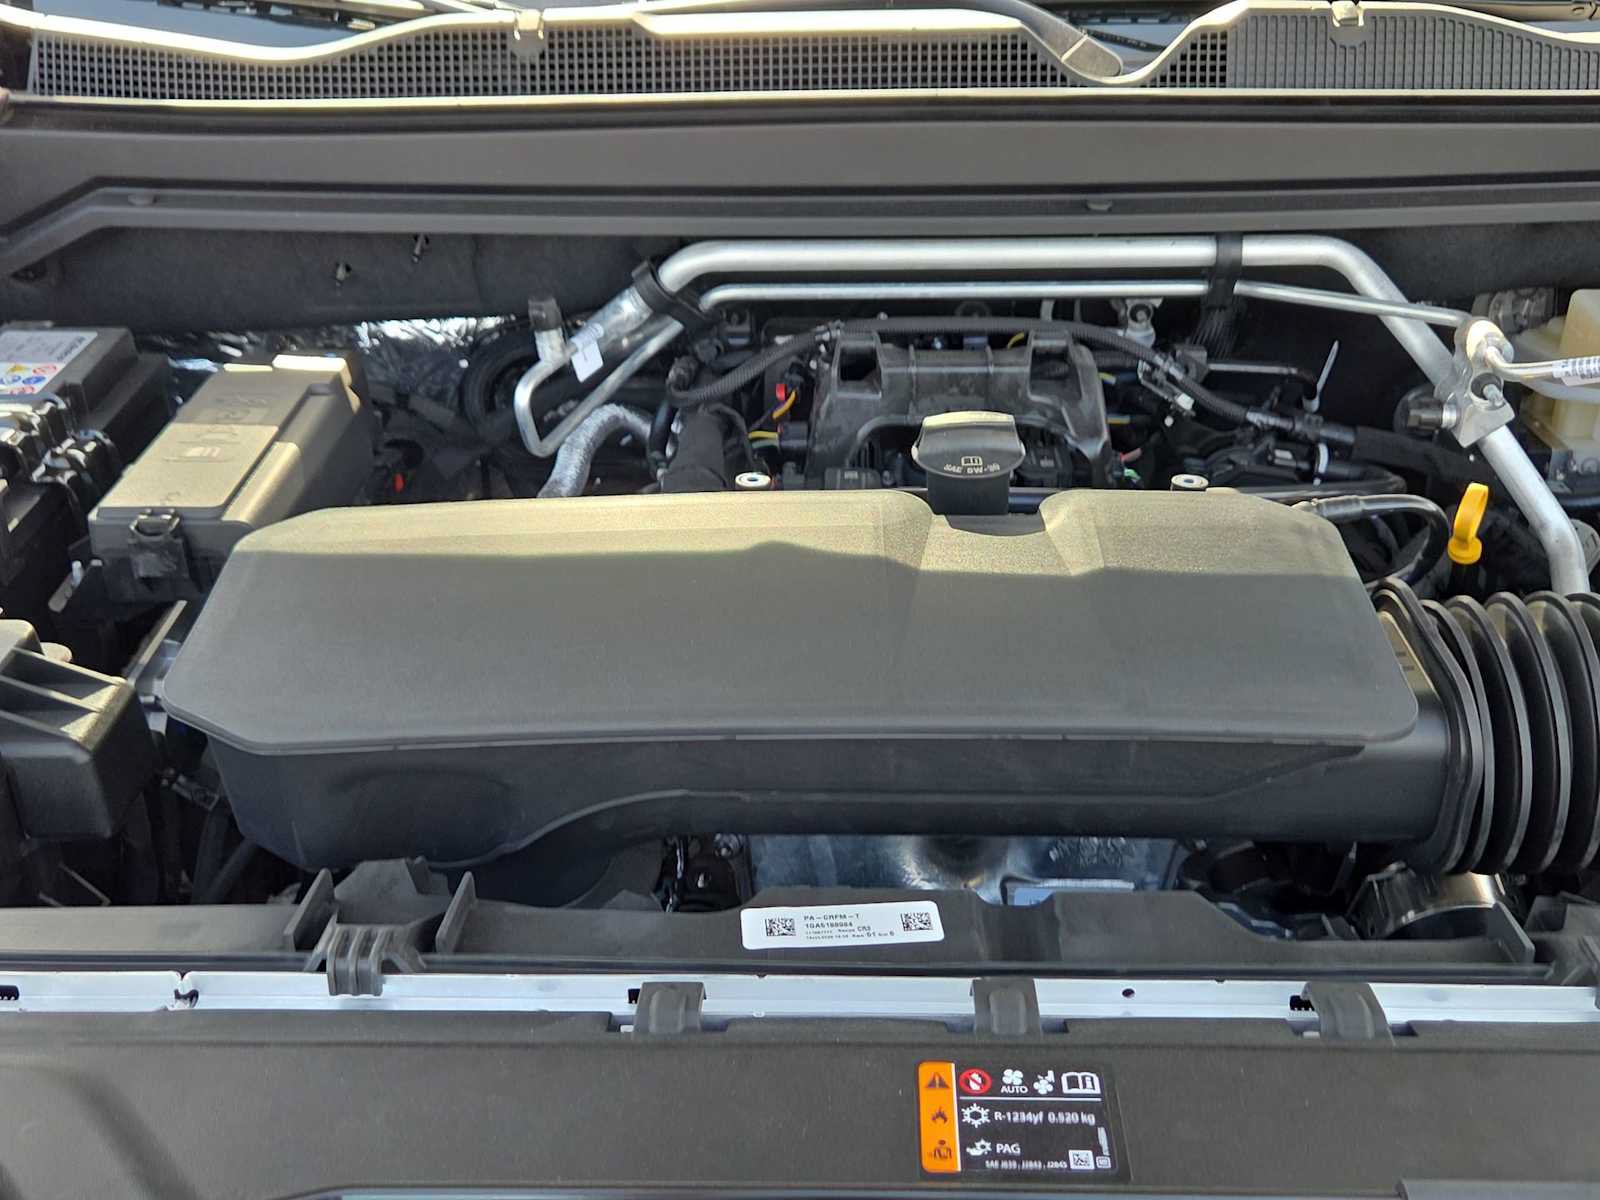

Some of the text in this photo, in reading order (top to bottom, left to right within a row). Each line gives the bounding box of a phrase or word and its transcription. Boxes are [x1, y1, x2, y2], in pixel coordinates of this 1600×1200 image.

[1000, 1085, 1029, 1094] AUTO
[994, 1111, 1044, 1125] R-1234yf
[1080, 1111, 1096, 1127] kg
[996, 1143, 1021, 1154] PAG
